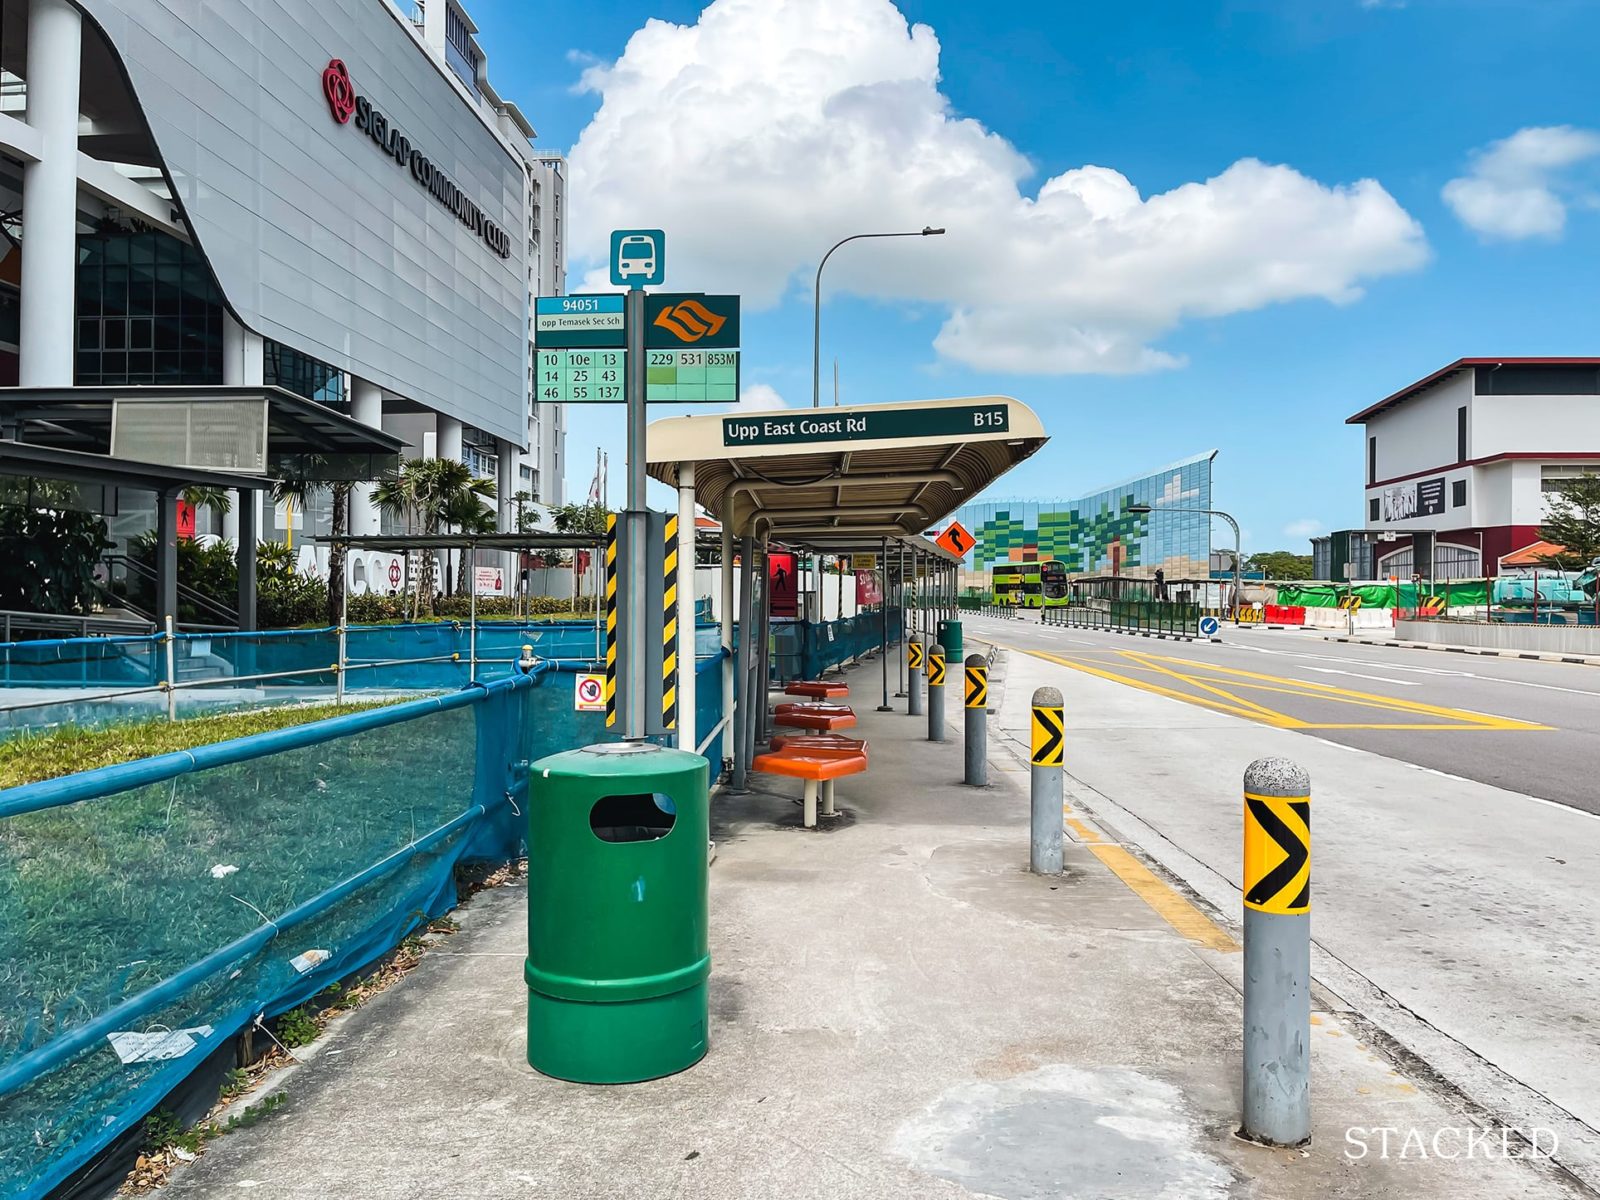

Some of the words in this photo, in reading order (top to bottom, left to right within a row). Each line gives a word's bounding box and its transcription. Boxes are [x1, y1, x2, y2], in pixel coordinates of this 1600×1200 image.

[355, 96, 411, 166] SIGLAP
[410, 150, 486, 237] COMMUNITY
[485, 220, 511, 258] CLUB
[562, 299, 599, 312] 94051
[541, 319, 557, 328] opp
[558, 317, 591, 326] Temasek
[592, 316, 605, 325] Sec
[607, 316, 620, 325] Sch
[544, 354, 558, 366] 10
[569, 354, 590, 366] 10e
[603, 354, 617, 366] 13
[651, 354, 674, 366] 229
[681, 353, 702, 366] 531
[707, 353, 735, 366] 853M
[545, 371, 559, 382] 14
[573, 370, 588, 382] 25
[601, 370, 616, 382] 43
[544, 387, 559, 399] 46
[573, 387, 588, 399] 55
[598, 387, 620, 399] 137
[973, 411, 1004, 427] B15
[728, 423, 759, 439] Upp
[764, 420, 797, 436] East
[800, 419, 842, 433] Coast
[846, 417, 867, 432] Rd
